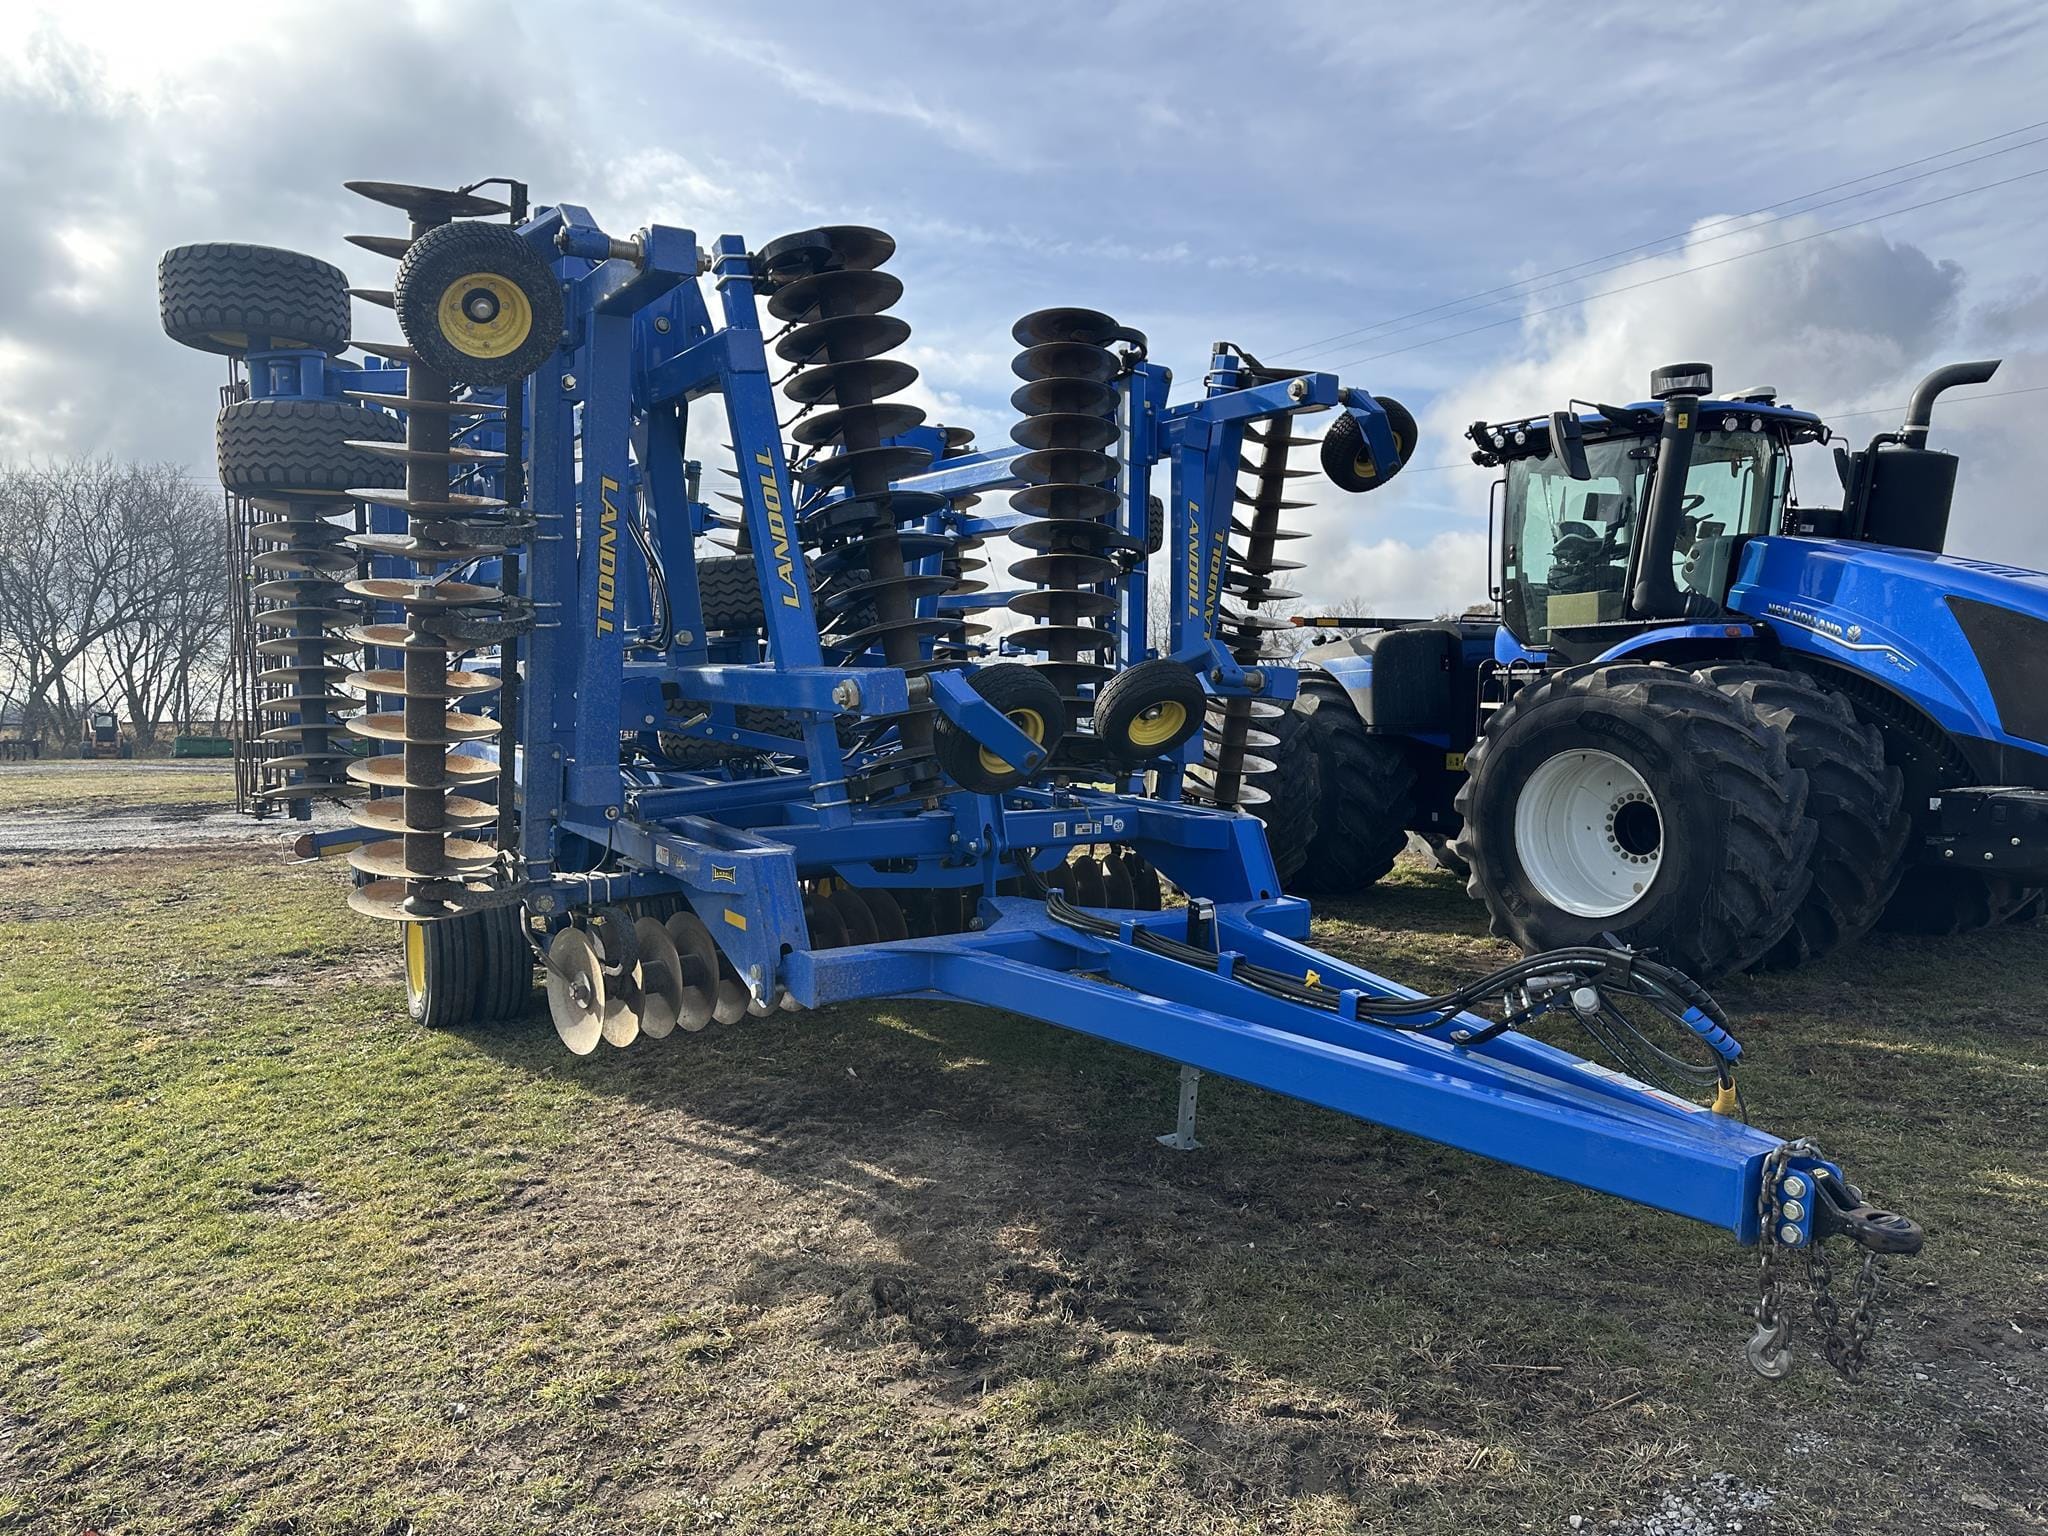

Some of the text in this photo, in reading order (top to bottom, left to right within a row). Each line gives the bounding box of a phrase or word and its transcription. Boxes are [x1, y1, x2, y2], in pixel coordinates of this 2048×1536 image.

[596, 474, 620, 640] LANDOLL
[756, 447, 801, 609] LANDOLL
[1188, 500, 1200, 621] LANDOLL
[1203, 528, 1225, 640] LANDOLL
[1768, 602, 1843, 637] NEW HOLLAND
